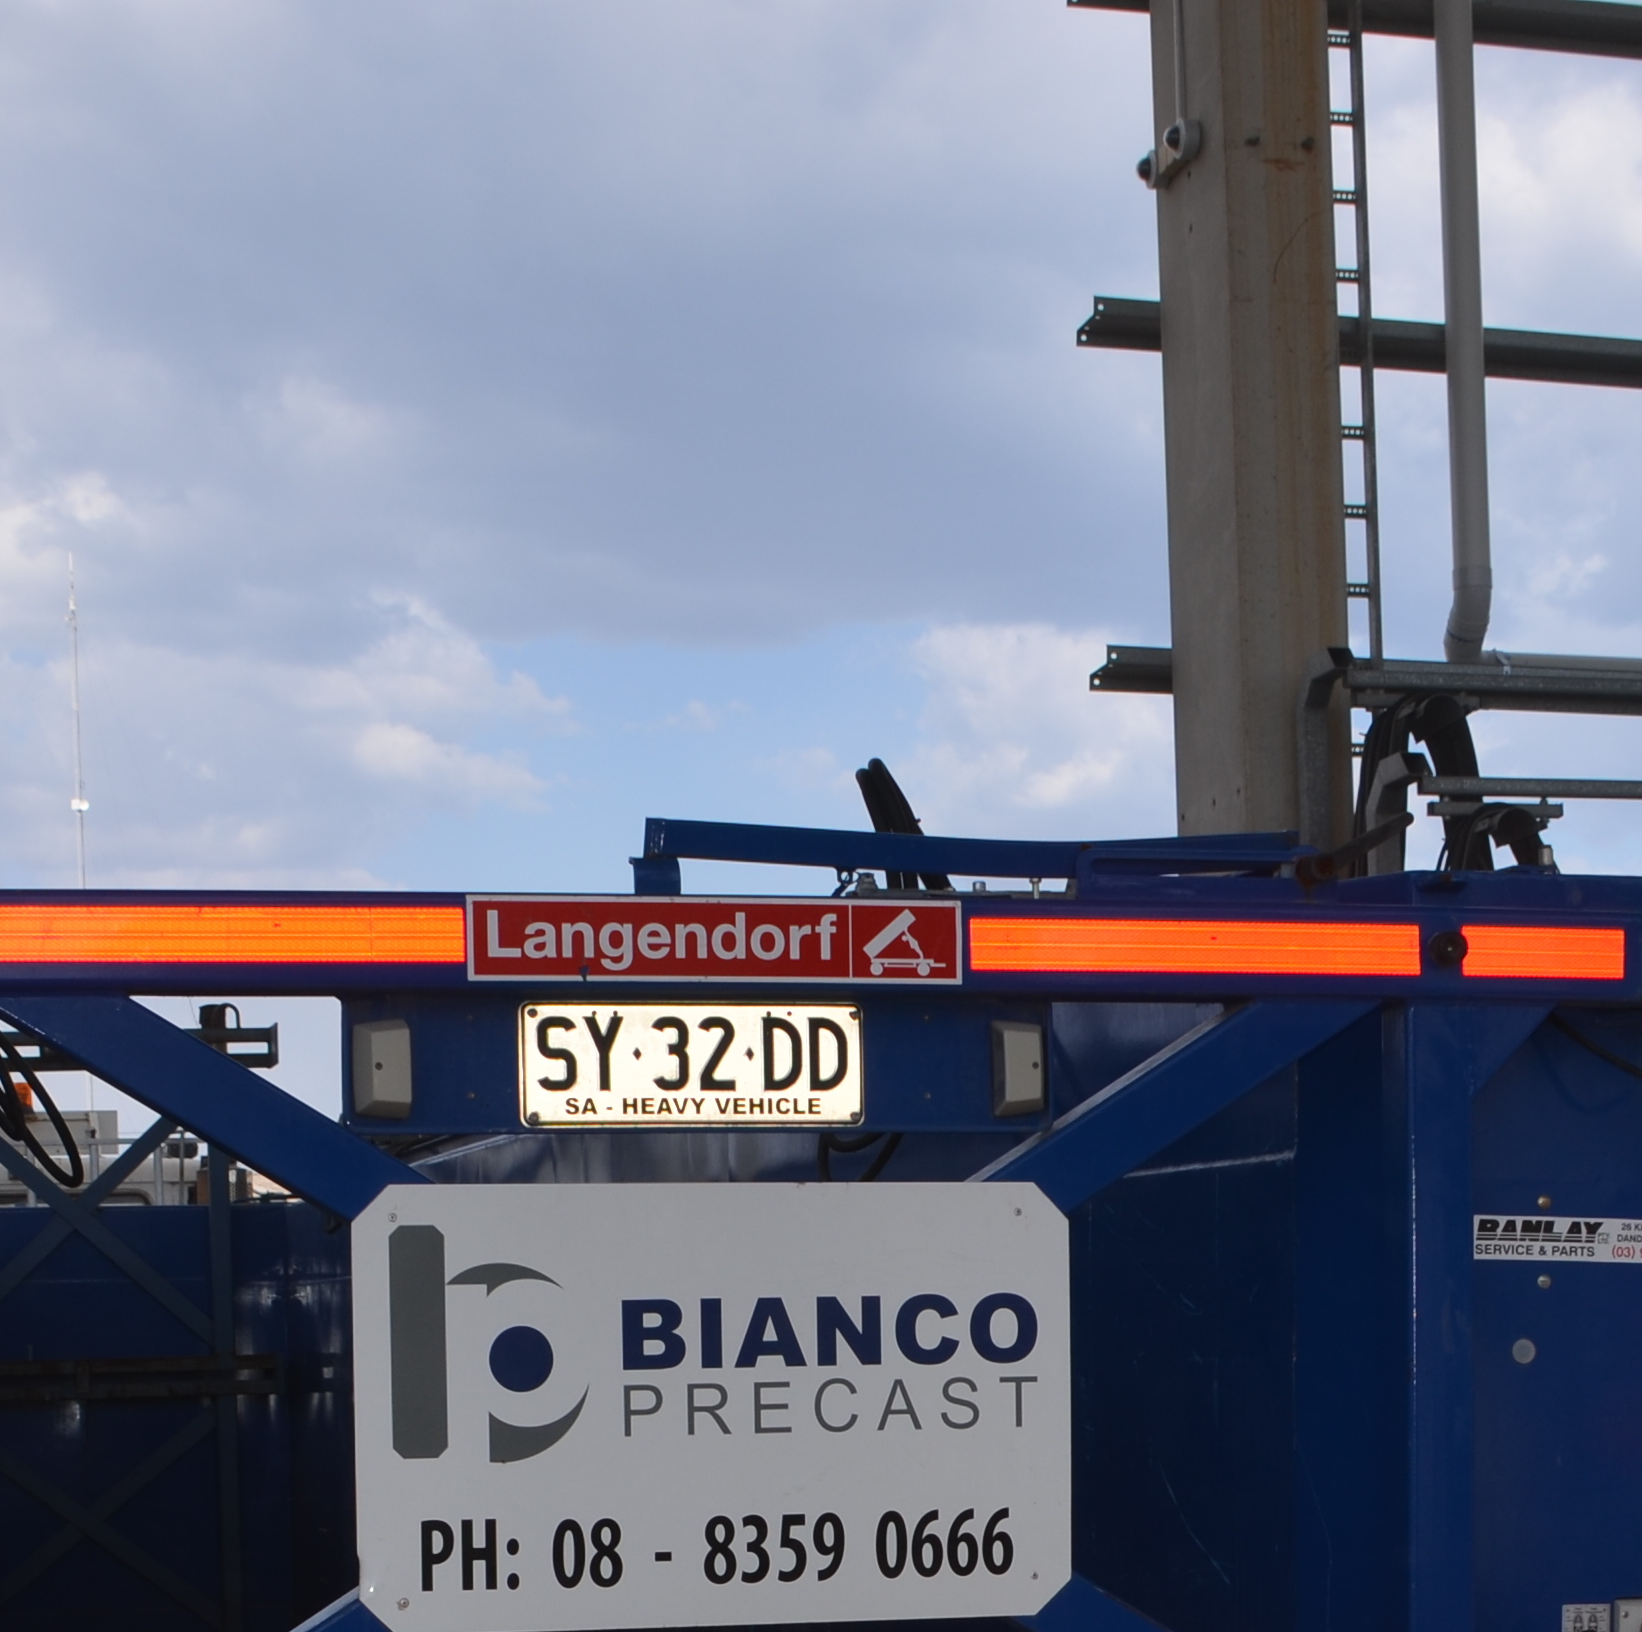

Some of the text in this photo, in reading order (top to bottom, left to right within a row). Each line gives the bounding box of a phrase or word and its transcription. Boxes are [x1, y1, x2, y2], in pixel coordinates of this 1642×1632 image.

[487, 909, 837, 971] Langendorf
[536, 1016, 848, 1091] SY 32 DD
[565, 1098, 598, 1114] SA
[622, 1098, 705, 1115] HEAVY
[714, 1098, 821, 1115] VEHICLE
[1475, 1244, 1595, 1257] SERVICE & PARTS
[1612, 1244, 1636, 1260] (03)
[621, 1293, 1038, 1371] BIANCO
[623, 1376, 1038, 1438] PRECAST
[420, 1519, 520, 1592] PH:
[552, 1518, 624, 1589] 08
[703, 1512, 845, 1586] 8359
[875, 1507, 1014, 1580] 0666
